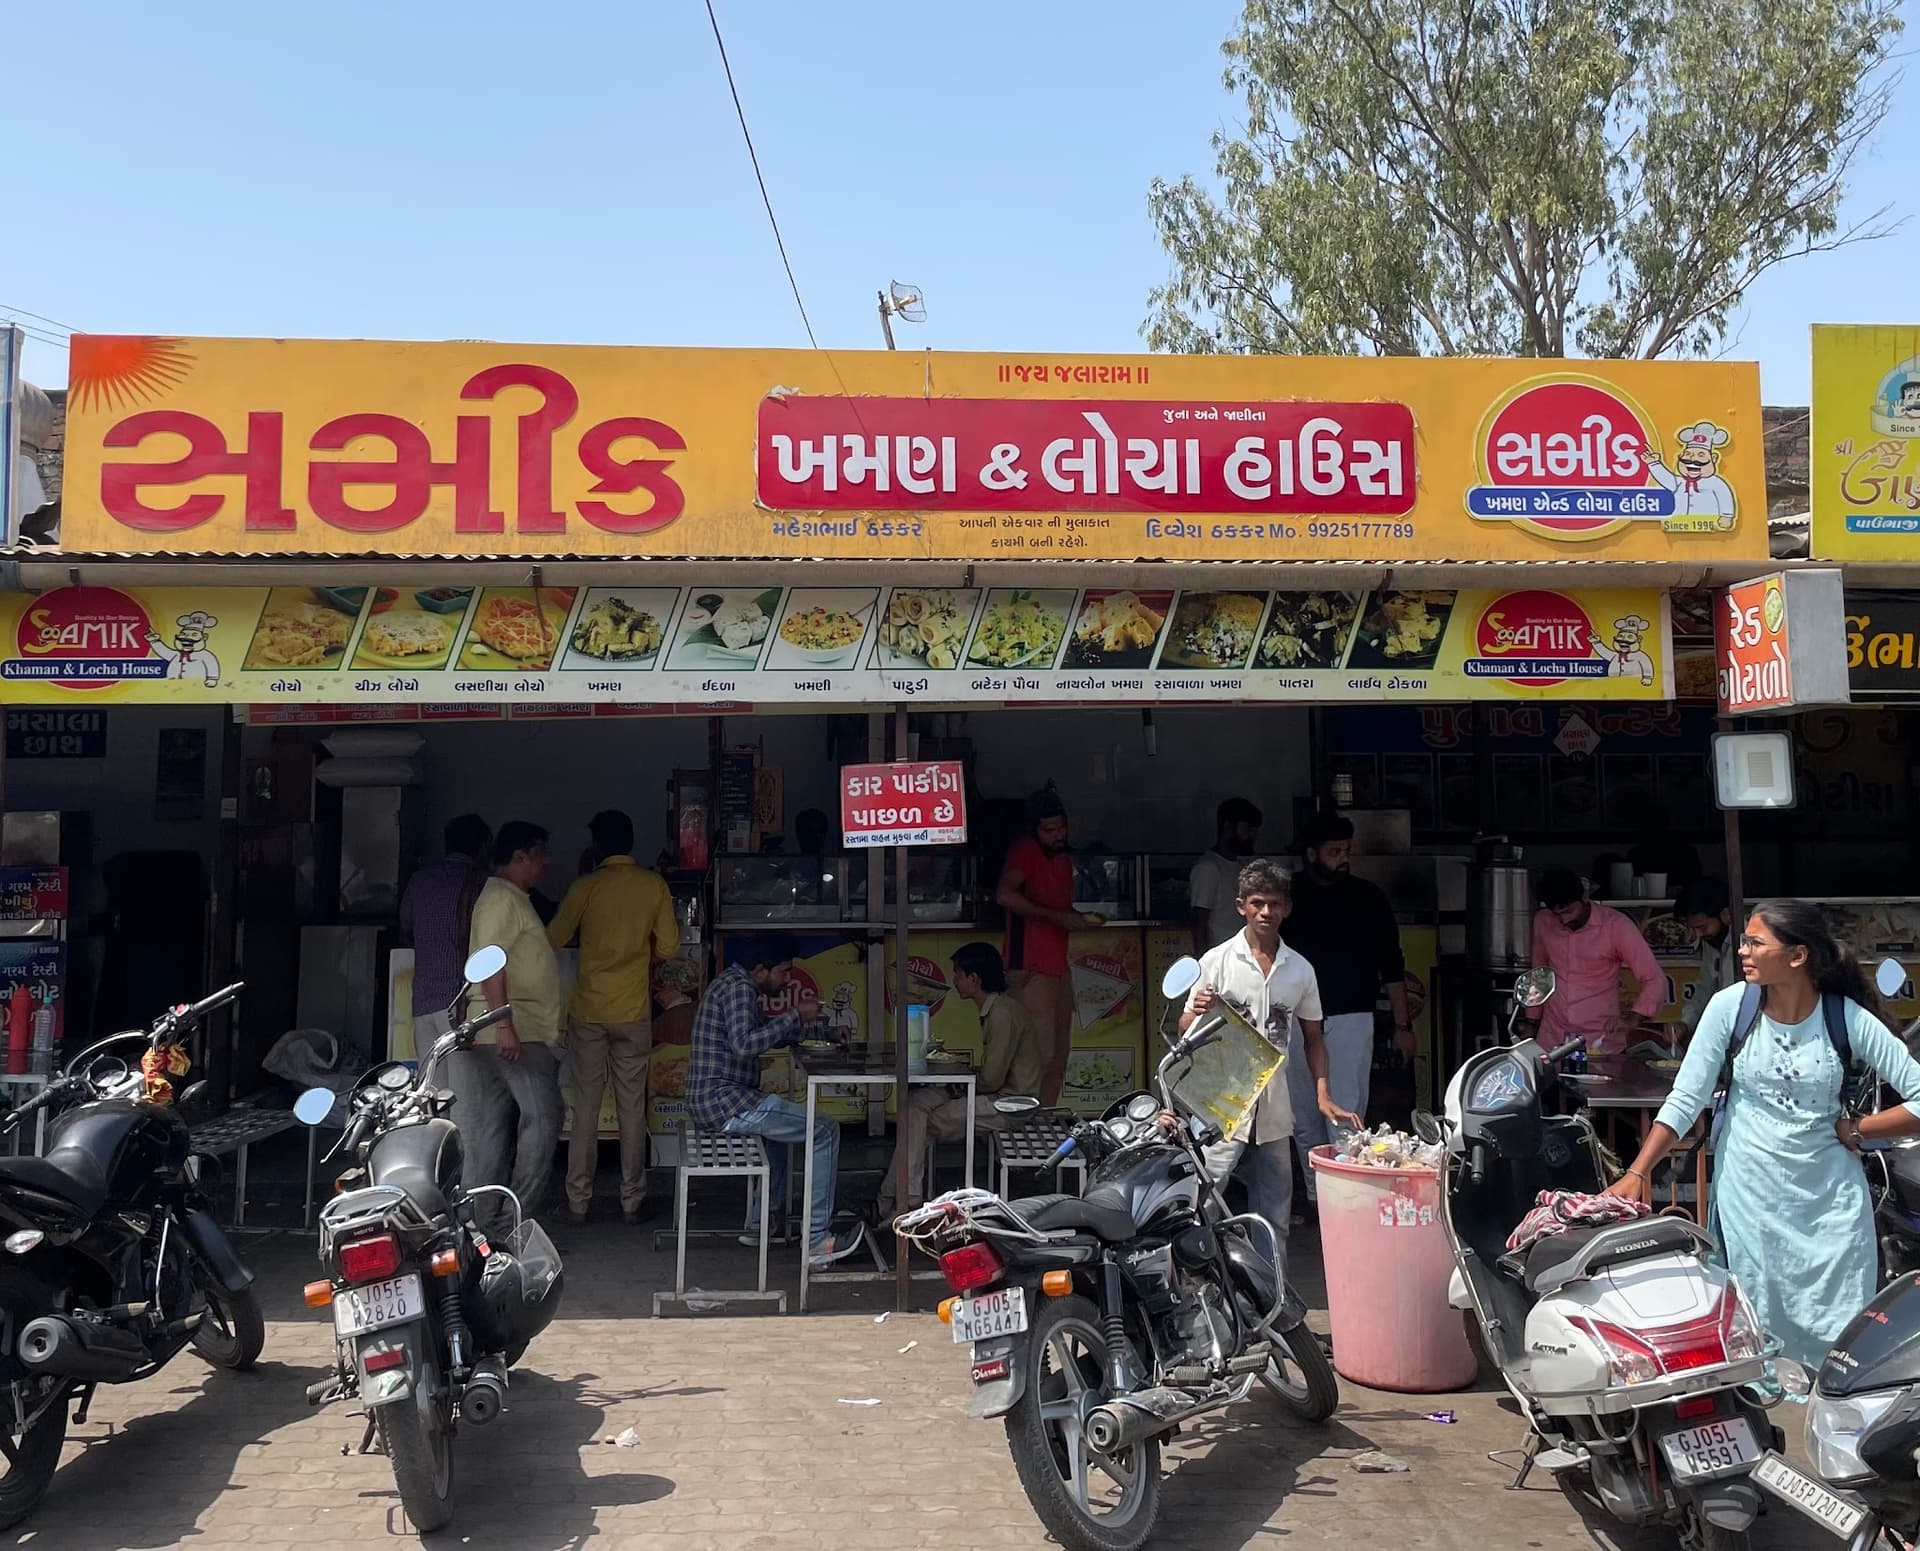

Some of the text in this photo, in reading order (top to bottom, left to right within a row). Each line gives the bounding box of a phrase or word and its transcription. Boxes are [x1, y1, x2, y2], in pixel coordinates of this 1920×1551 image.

[1162, 406, 1266, 424] જુના અને જાણીતા
[1890, 423, 1916, 433] Since
[100, 363, 688, 536] સમીક
[1496, 414, 1642, 477] સમીક
[771, 411, 1404, 501] ખમણ & લોચા હાઉસ
[1485, 491, 1660, 512] ખમણ એન્ડ લોચા હાઉસ
[773, 517, 858, 538] મહેશભાઈ
[959, 517, 998, 529] આપની
[1047, 517, 1062, 529] ની
[1065, 518, 1111, 531] મુલાકાત
[1145, 518, 1202, 539] દિવ્યેશ
[1269, 523, 1303, 538] Mo.
[1307, 522, 1415, 538] 9925177789
[1664, 520, 1689, 531] Since
[990, 536, 1025, 548] કાયમી
[1029, 537, 1053, 548] બની
[4, 663, 162, 675] Khaman & Locha House
[1467, 661, 1604, 674] Khaman & Locha House
[270, 678, 301, 692] લોચો
[354, 678, 419, 692] ચીઝ લોચો
[454, 677, 545, 692] લસણીયા લોચો
[588, 681, 622, 692] ખમણ
[794, 679, 831, 692] ખમણી
[892, 677, 929, 693] પાટુડી
[971, 676, 1007, 690] બટેકા
[1056, 677, 1143, 691] નાયલોન ખમણ
[1154, 680, 1242, 690] રસાવાળા ખમણ
[1279, 678, 1314, 689] પાતરા
[1387, 676, 1427, 690] ઢોકળા
[847, 775, 883, 797] કાર
[851, 798, 955, 826] પાછળ છે
[1614, 1239, 1659, 1254] HONDA
[350, 1279, 405, 1307] GJ05E
[973, 1293, 1011, 1317] GJ05
[1677, 1425, 1737, 1453] GJ05L
[1774, 1470, 1854, 1528] GJ05PJ2014
